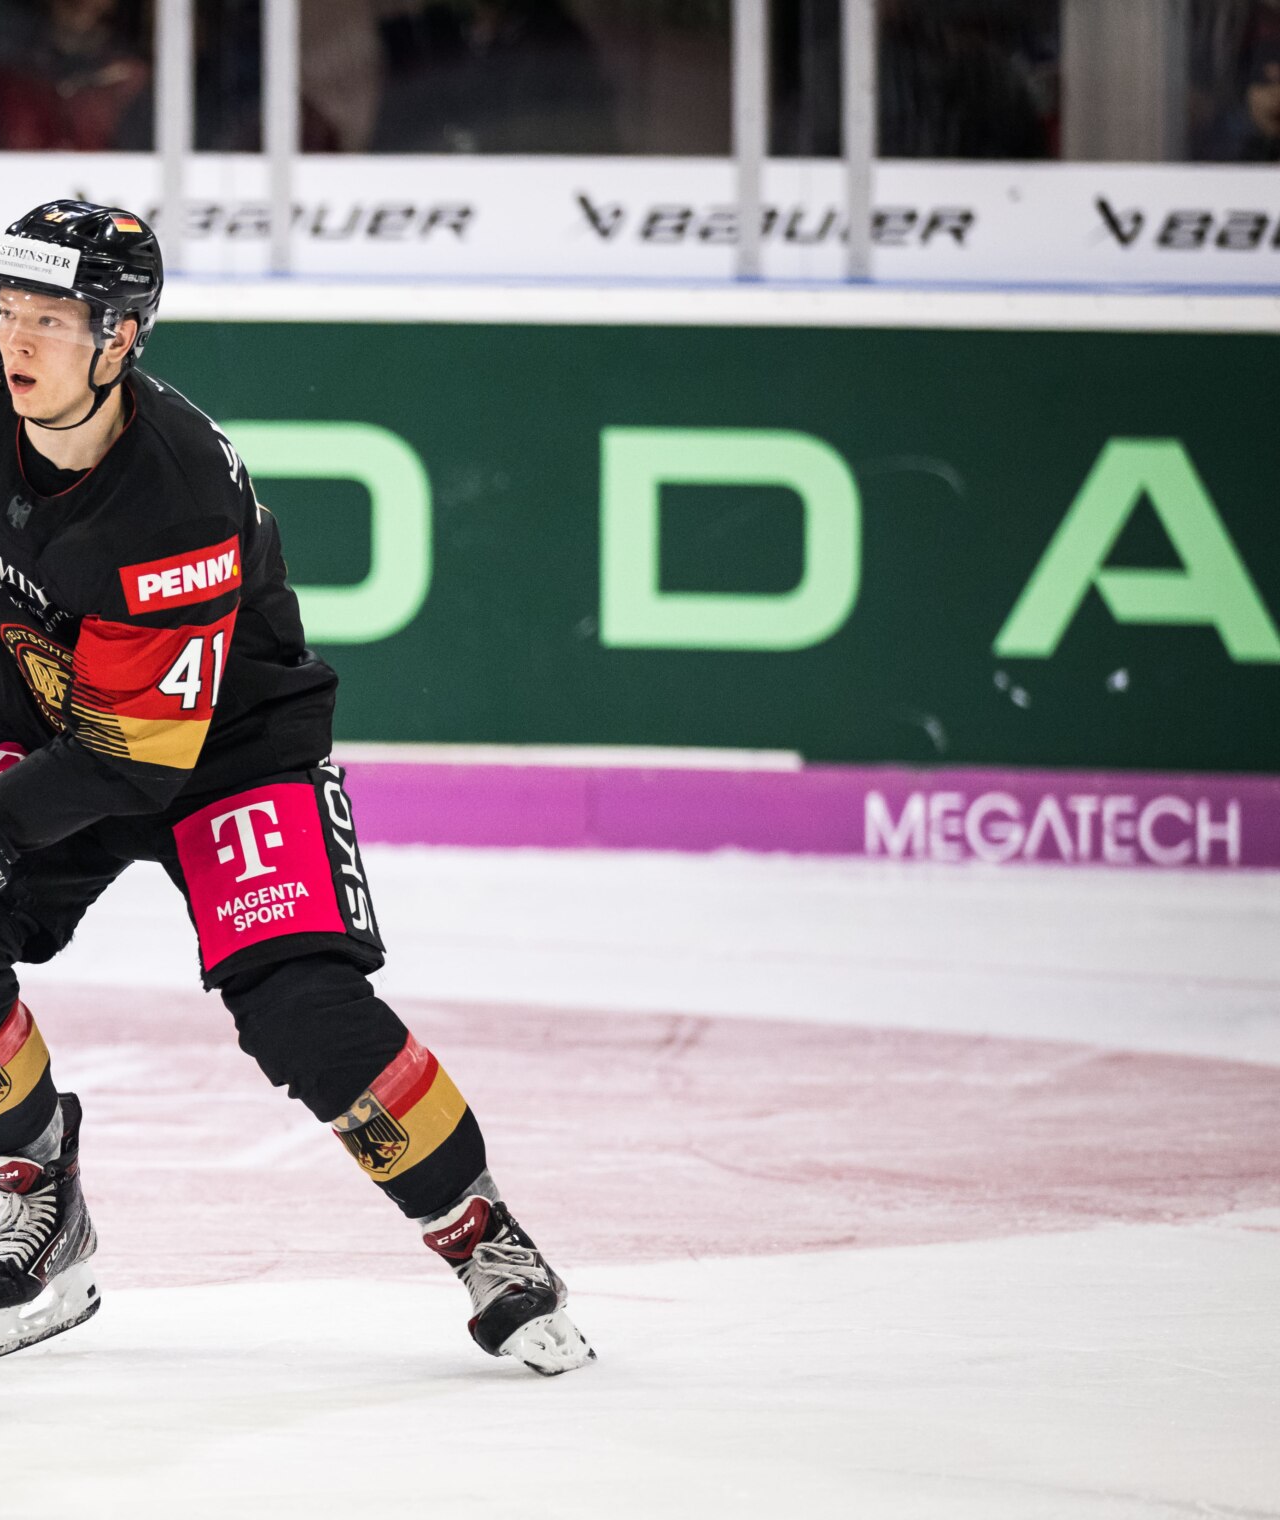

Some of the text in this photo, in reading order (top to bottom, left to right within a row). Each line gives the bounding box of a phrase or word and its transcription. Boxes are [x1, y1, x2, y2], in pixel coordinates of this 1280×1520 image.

[157, 630, 225, 711] 41
[863, 790, 1242, 867] MEGATECH
[216, 881, 310, 922] MAGENTA
[233, 901, 296, 933] SPORT
[43, 1230, 68, 1274] CCM
[435, 1216, 476, 1247] CCM
